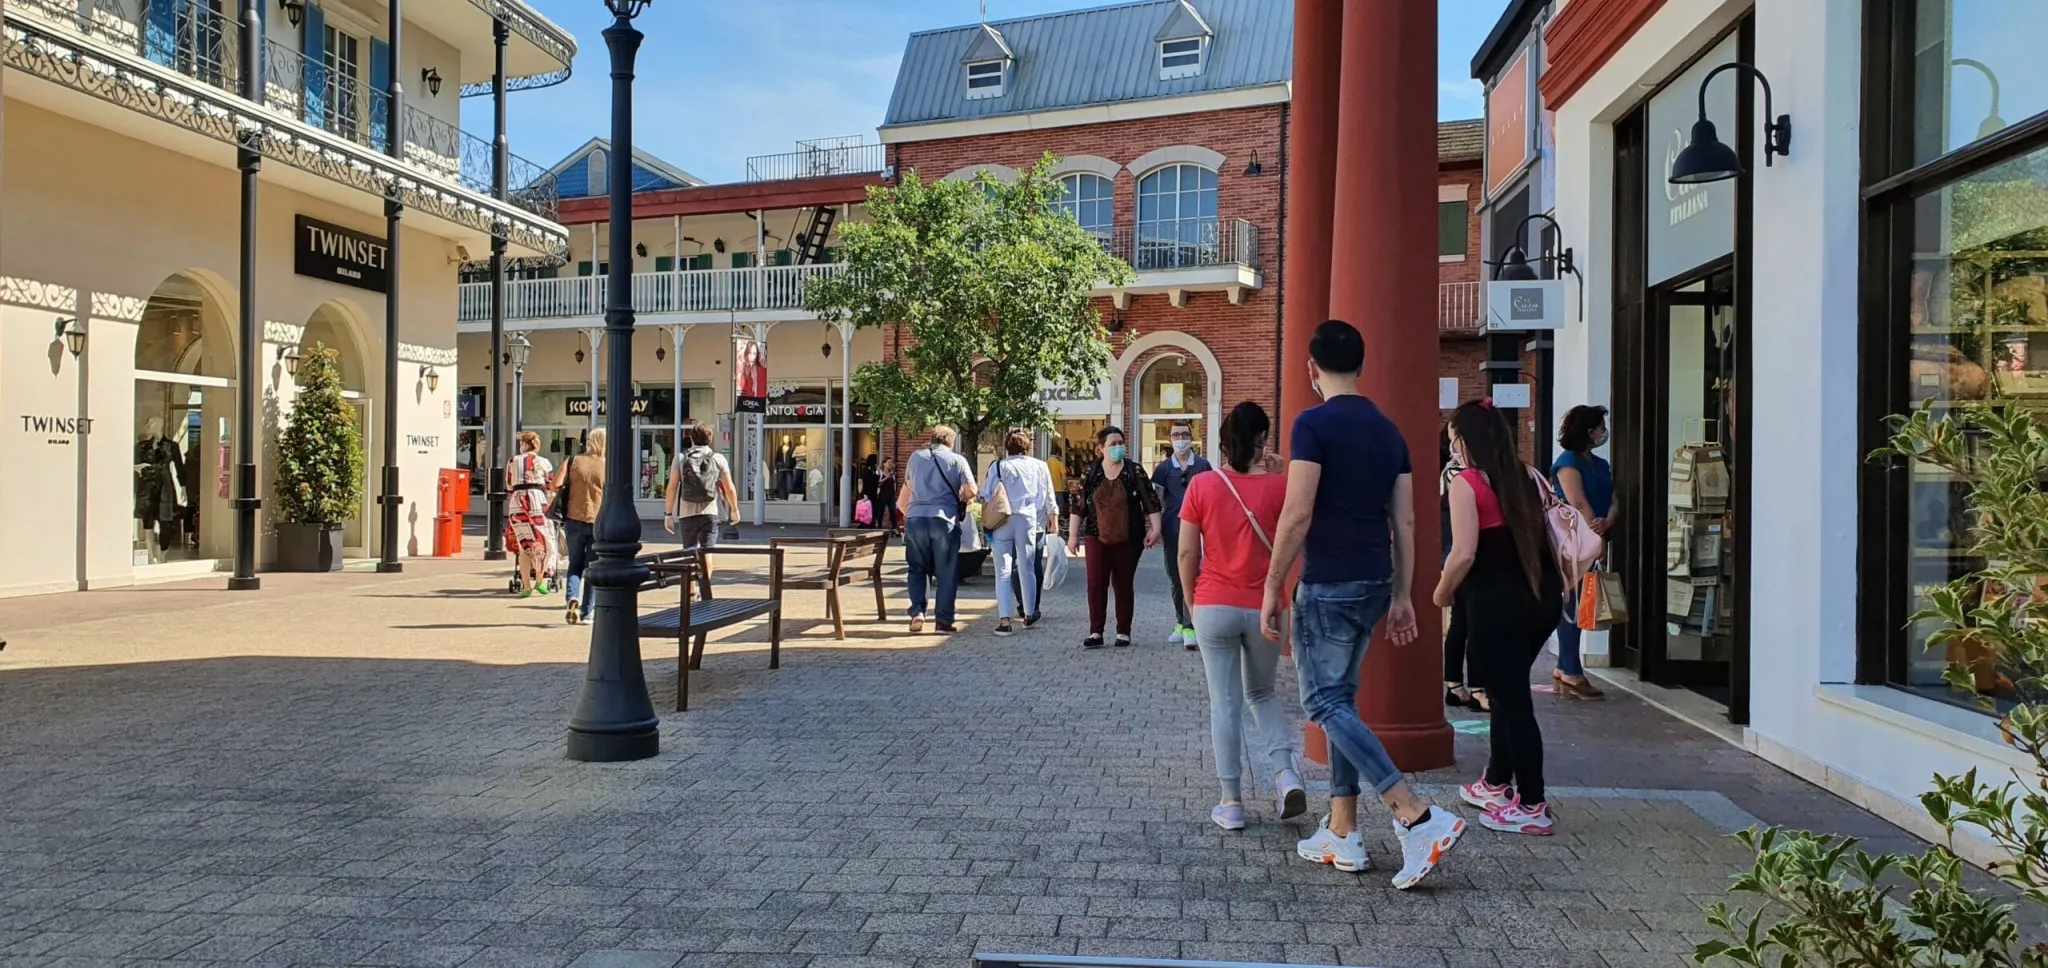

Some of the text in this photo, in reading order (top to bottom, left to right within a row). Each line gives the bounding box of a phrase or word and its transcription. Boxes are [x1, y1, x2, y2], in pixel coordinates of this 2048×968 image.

[306, 225, 388, 270] TWINSET
[20, 415, 95, 435] TWINSET
[406, 434, 440, 448] TWINSET
